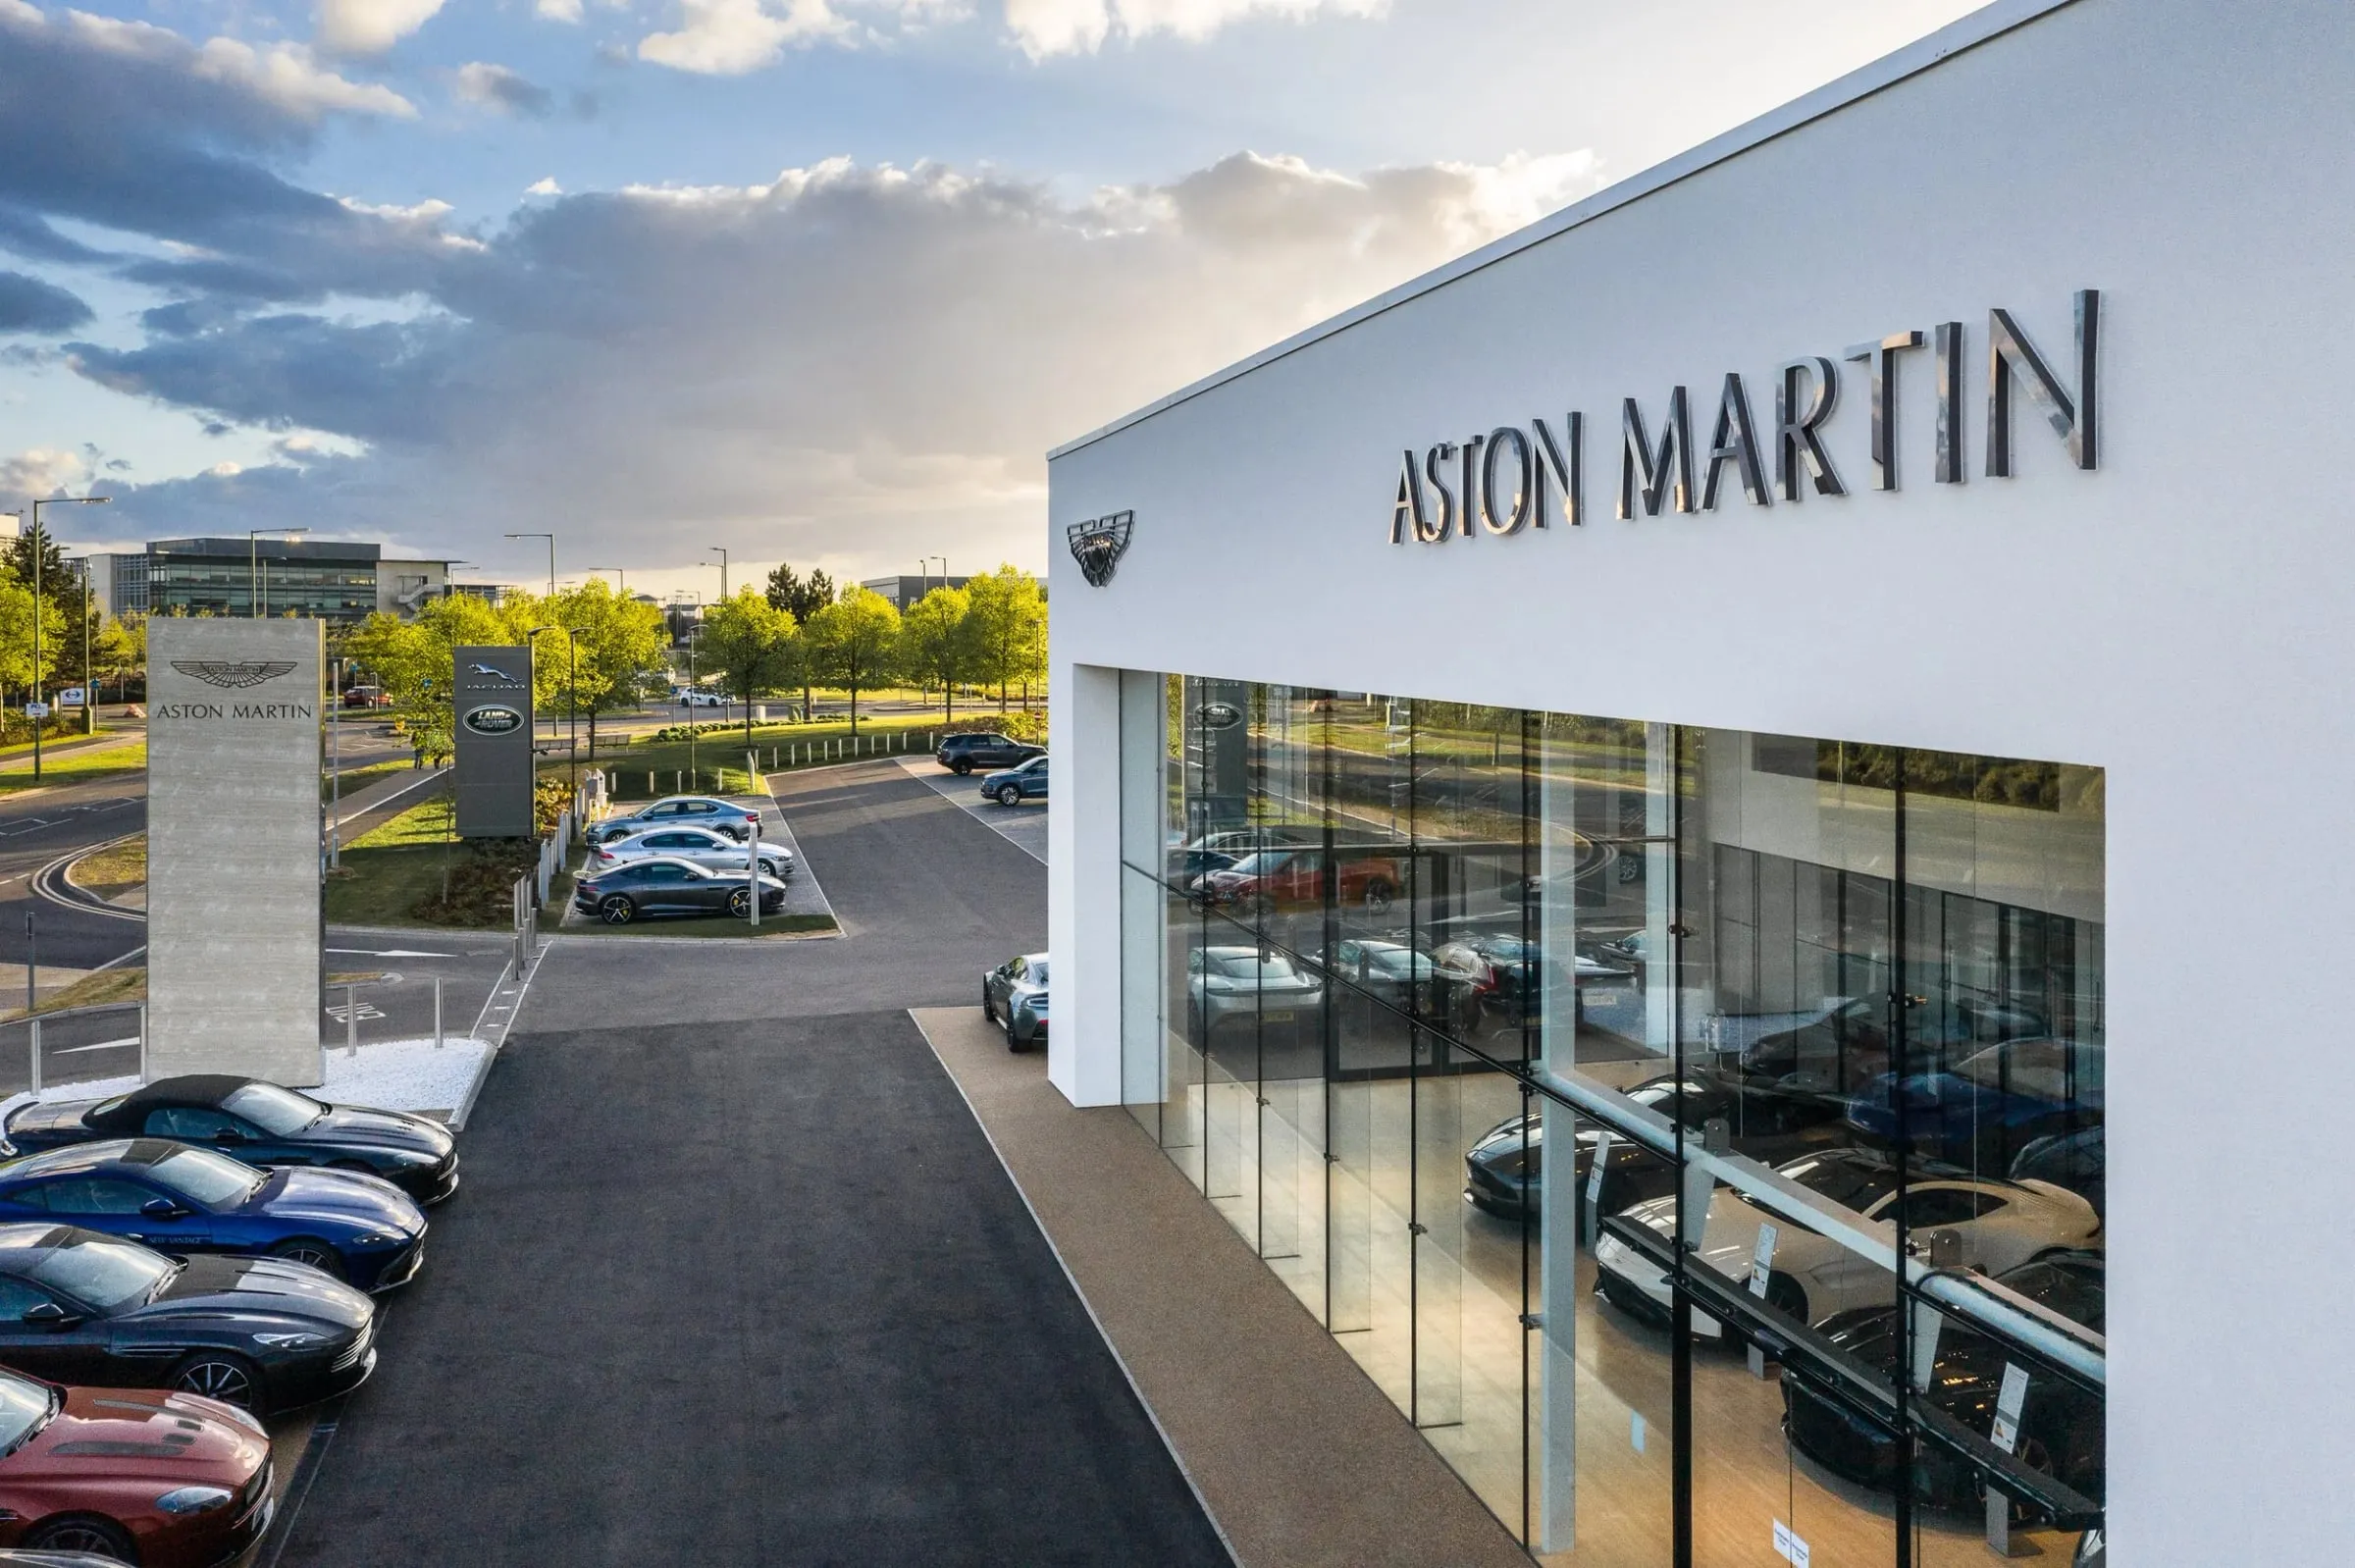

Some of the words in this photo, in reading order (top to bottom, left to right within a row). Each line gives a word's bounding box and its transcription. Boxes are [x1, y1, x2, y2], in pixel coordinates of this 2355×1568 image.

[1388, 411, 1582, 545] ASTON
[1616, 288, 2100, 521] MARTIN
[156, 705, 223, 718] ASTON
[233, 705, 311, 718] MARTIN
[480, 719, 513, 728] ROVER
